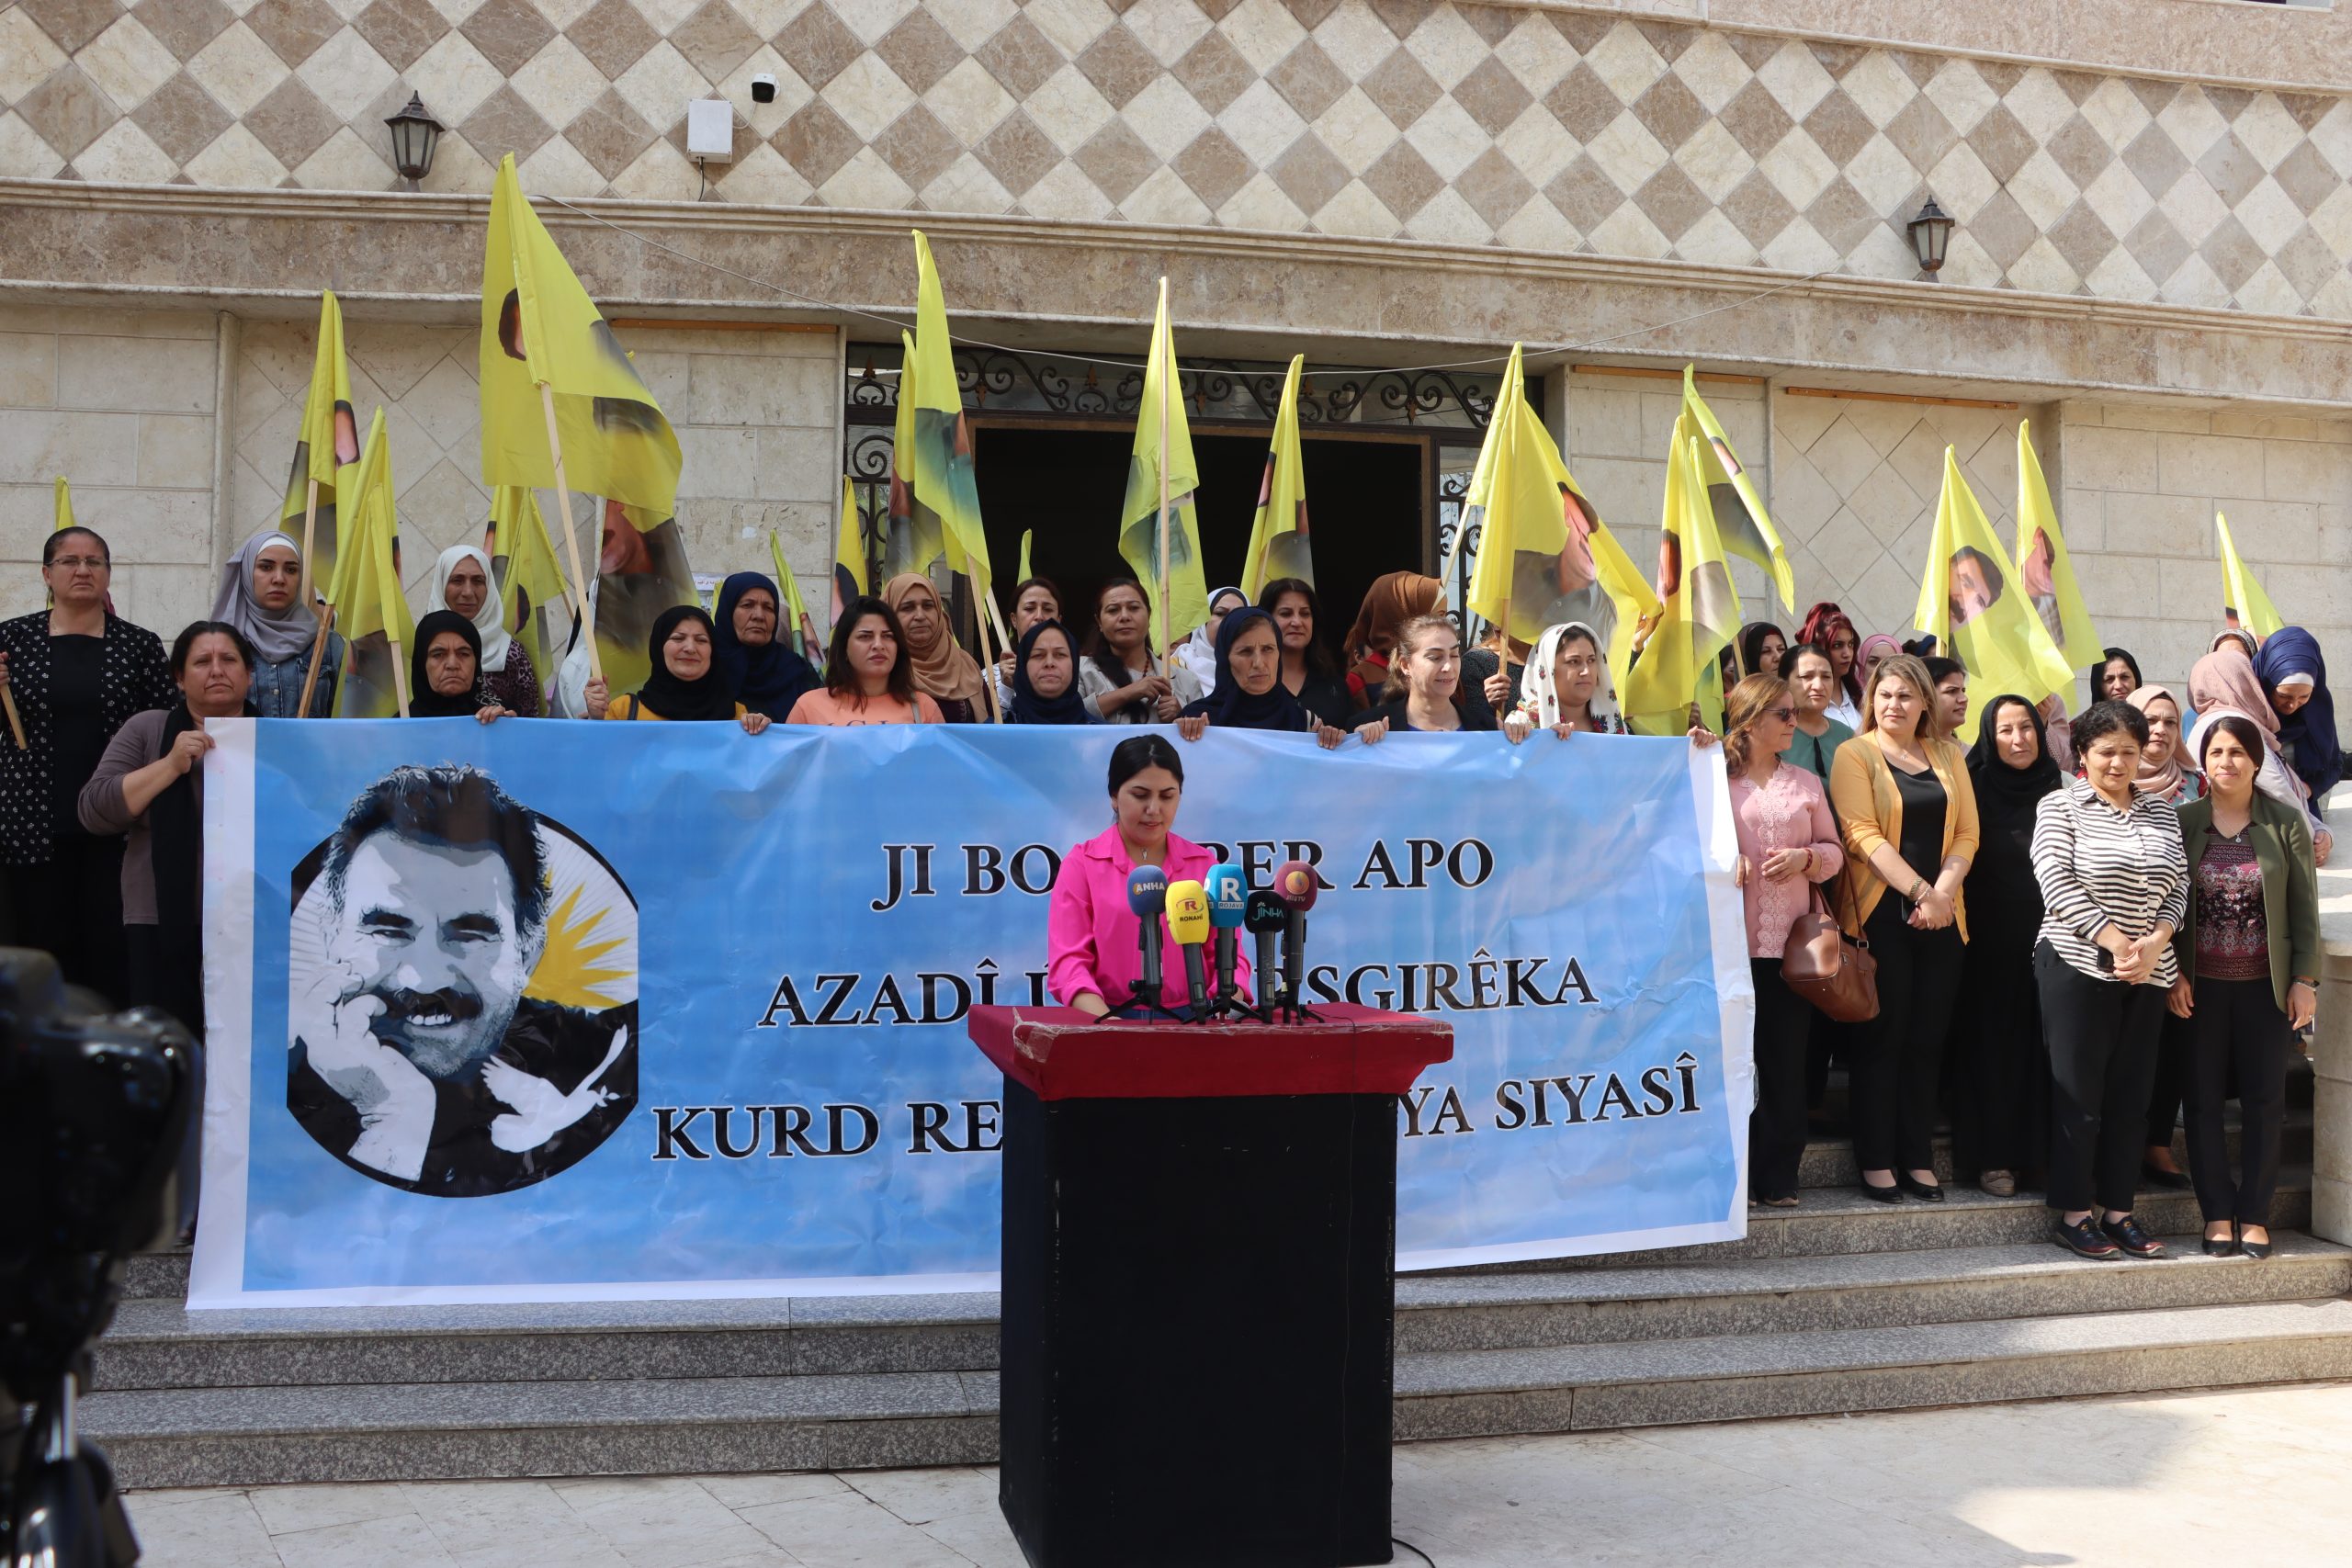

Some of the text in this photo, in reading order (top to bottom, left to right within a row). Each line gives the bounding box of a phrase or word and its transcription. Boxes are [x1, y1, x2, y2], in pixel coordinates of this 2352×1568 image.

[870, 844, 936, 912] JI
[1351, 838, 1494, 890] APO
[1136, 882, 1165, 893] ANHA
[1221, 878, 1242, 901] R
[757, 957, 1000, 1027] AZADÎ
[651, 1103, 880, 1160] KURD
[1495, 1051, 1702, 1131] SIYASÎ
